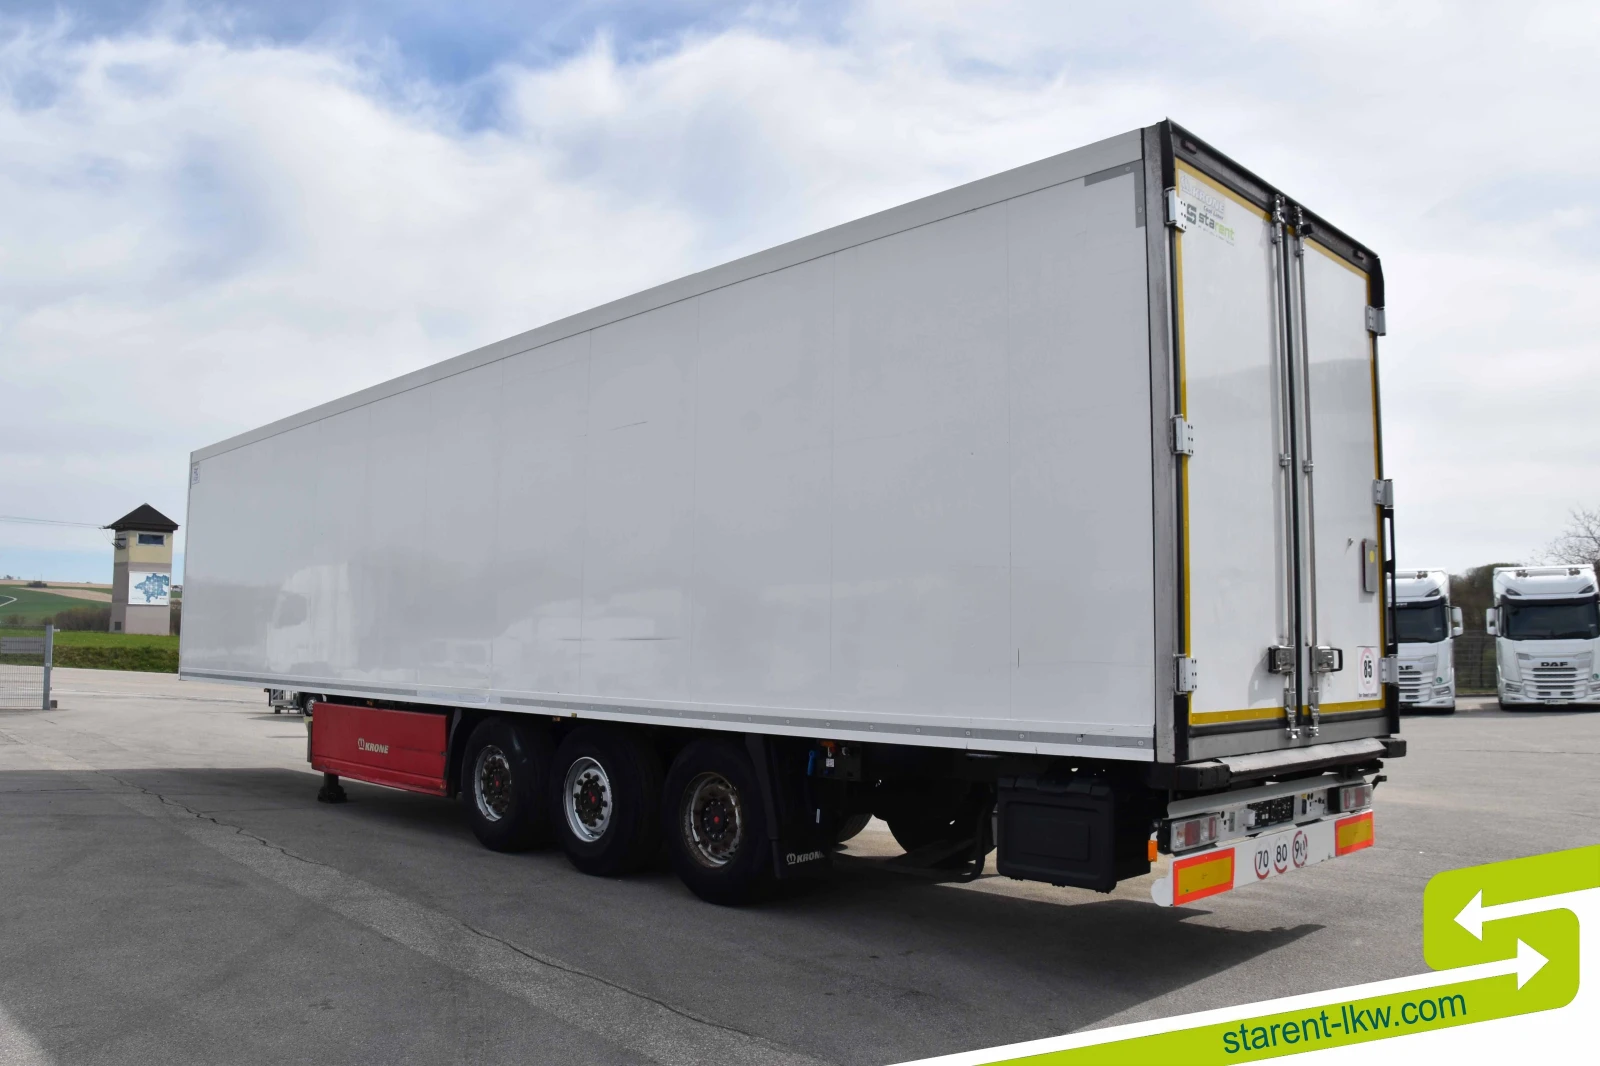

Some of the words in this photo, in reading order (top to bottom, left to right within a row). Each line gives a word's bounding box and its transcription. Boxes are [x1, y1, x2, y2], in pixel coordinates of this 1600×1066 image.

[1192, 187, 1225, 214] KRONE
[1198, 212, 1235, 241] starent
[1363, 659, 1373, 679] 85
[365, 742, 389, 754] KRONE
[1257, 849, 1269, 870] 70
[1276, 843, 1288, 863] 80
